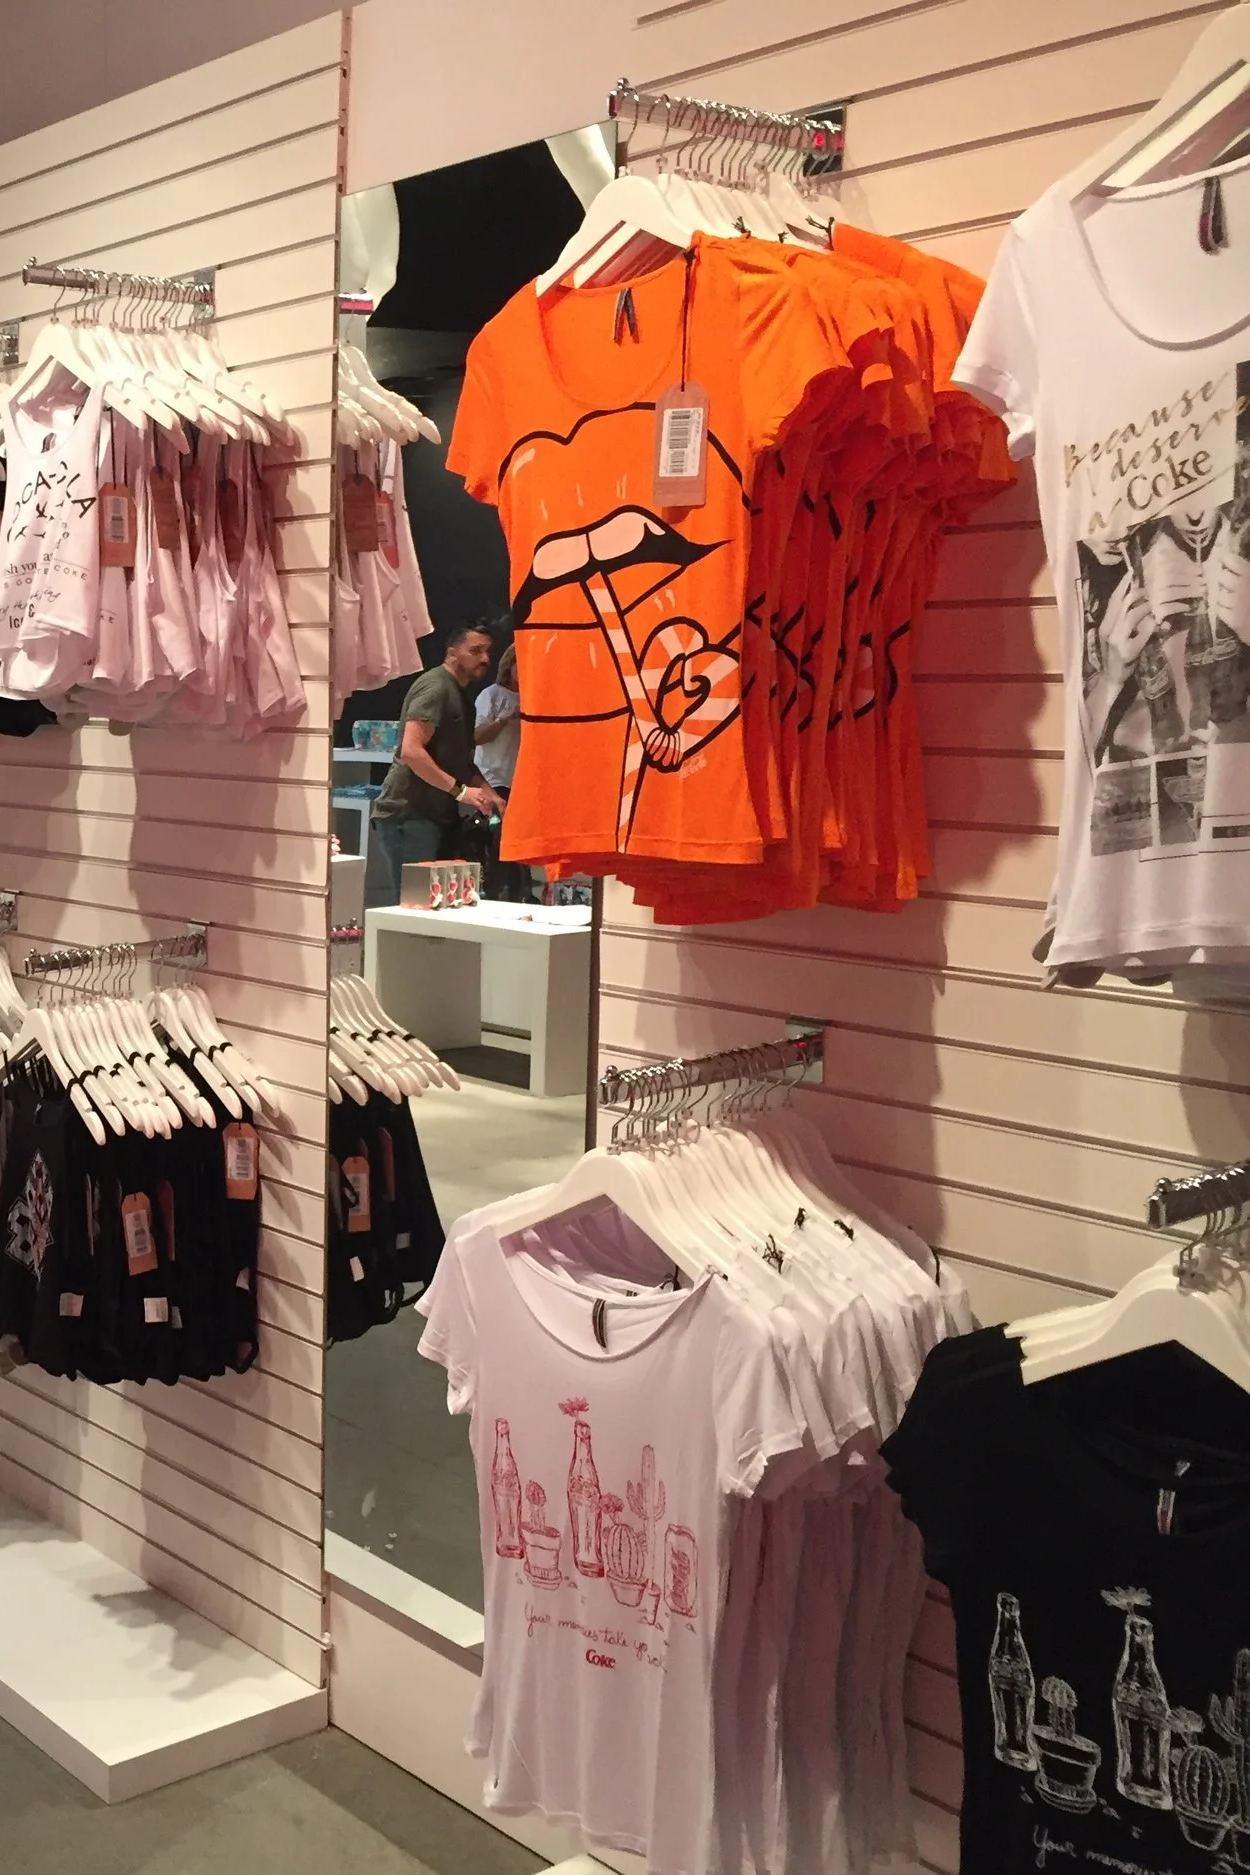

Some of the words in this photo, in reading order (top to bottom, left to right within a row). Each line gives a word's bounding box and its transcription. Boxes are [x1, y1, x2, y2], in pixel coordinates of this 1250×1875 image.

[1063, 371, 1230, 489] Because
[1126, 450, 1214, 511] Coke
[585, 1648, 617, 1670] Coke
